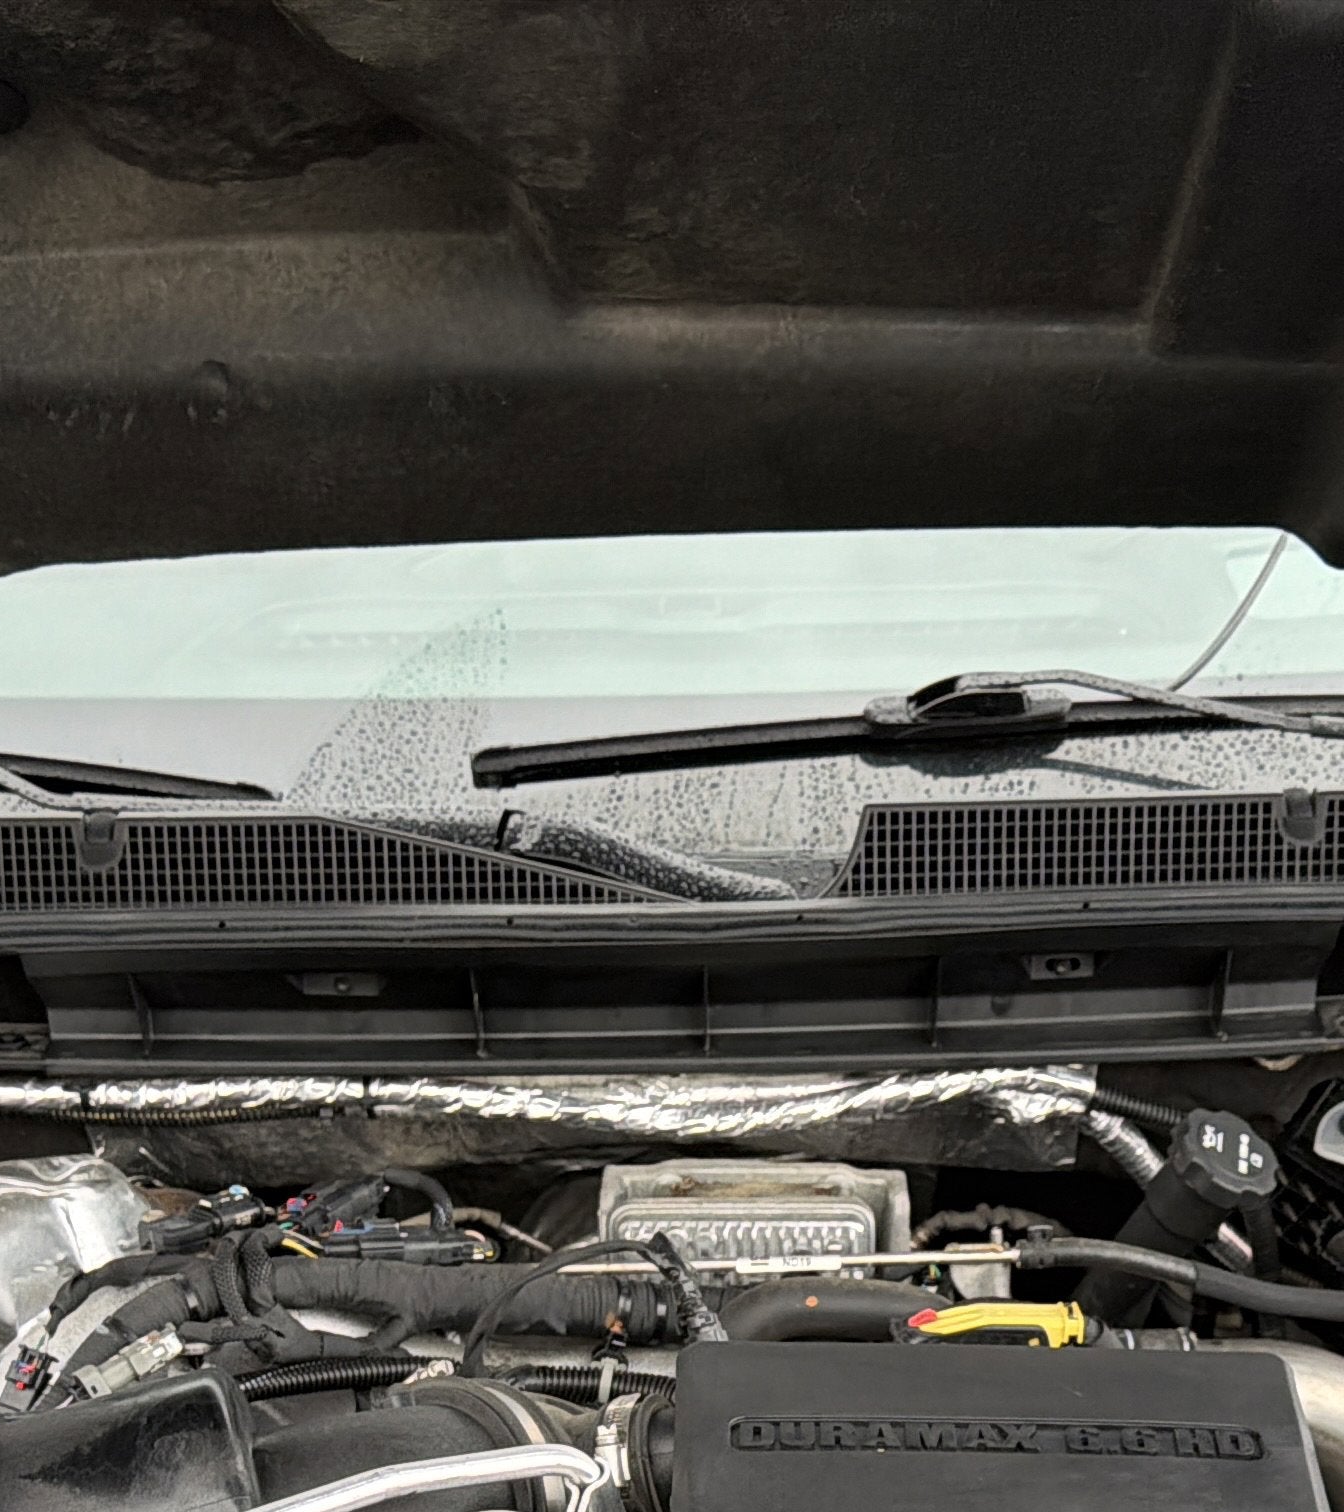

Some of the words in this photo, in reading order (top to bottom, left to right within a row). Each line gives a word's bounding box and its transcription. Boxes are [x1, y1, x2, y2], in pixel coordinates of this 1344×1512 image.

[731, 1419, 1041, 1453] DURAMAX
[1064, 1425, 1158, 1456] 6.6
[1172, 1428, 1263, 1460] HD
